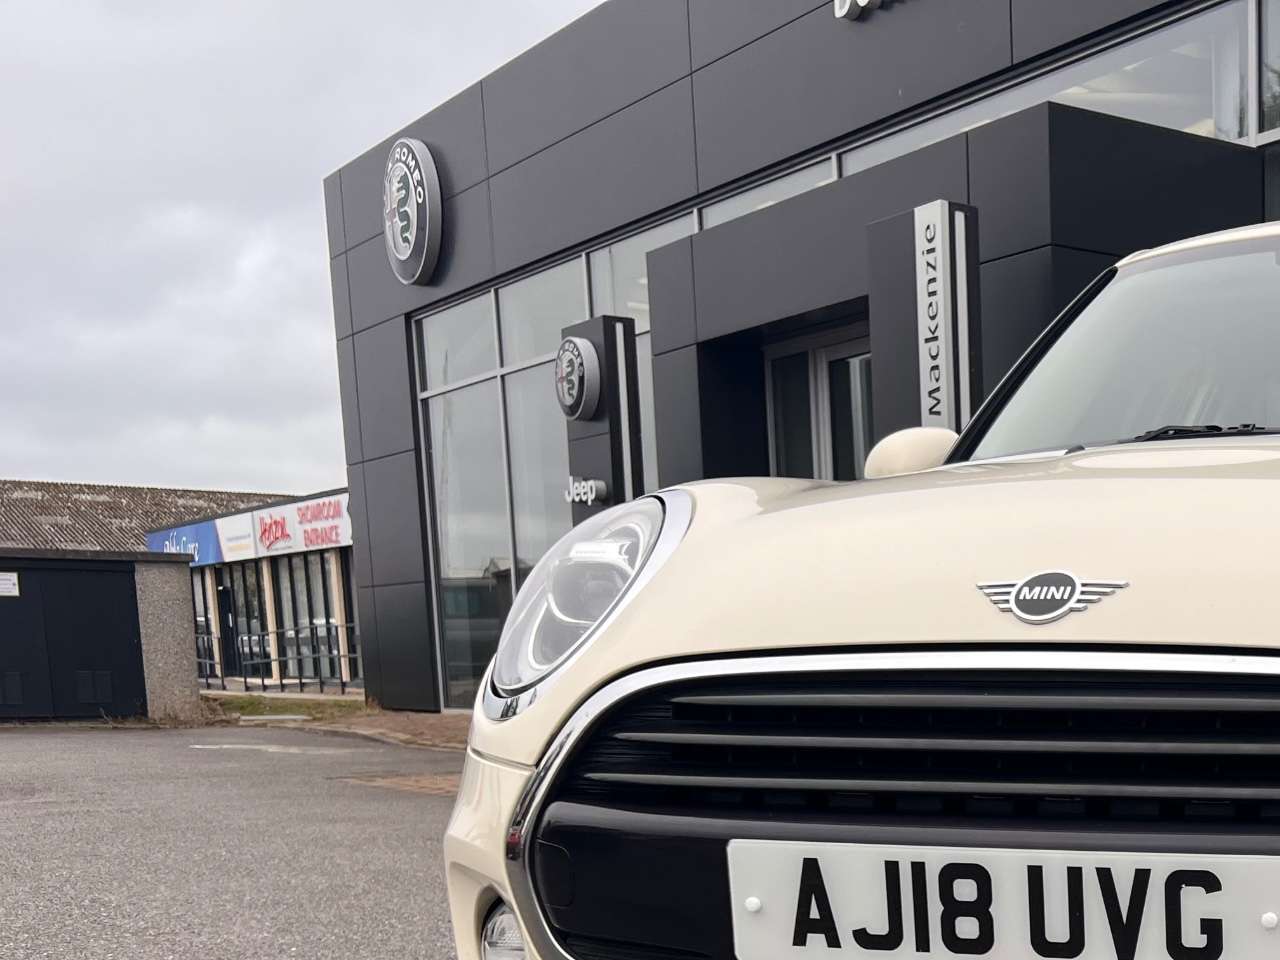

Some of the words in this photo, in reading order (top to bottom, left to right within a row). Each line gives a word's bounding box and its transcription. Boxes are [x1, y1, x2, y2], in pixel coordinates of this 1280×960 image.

[921, 224, 942, 416] Mackenzie
[565, 476, 597, 506] Jeep
[1019, 586, 1072, 601] MINI
[792, 857, 995, 955] AJ18
